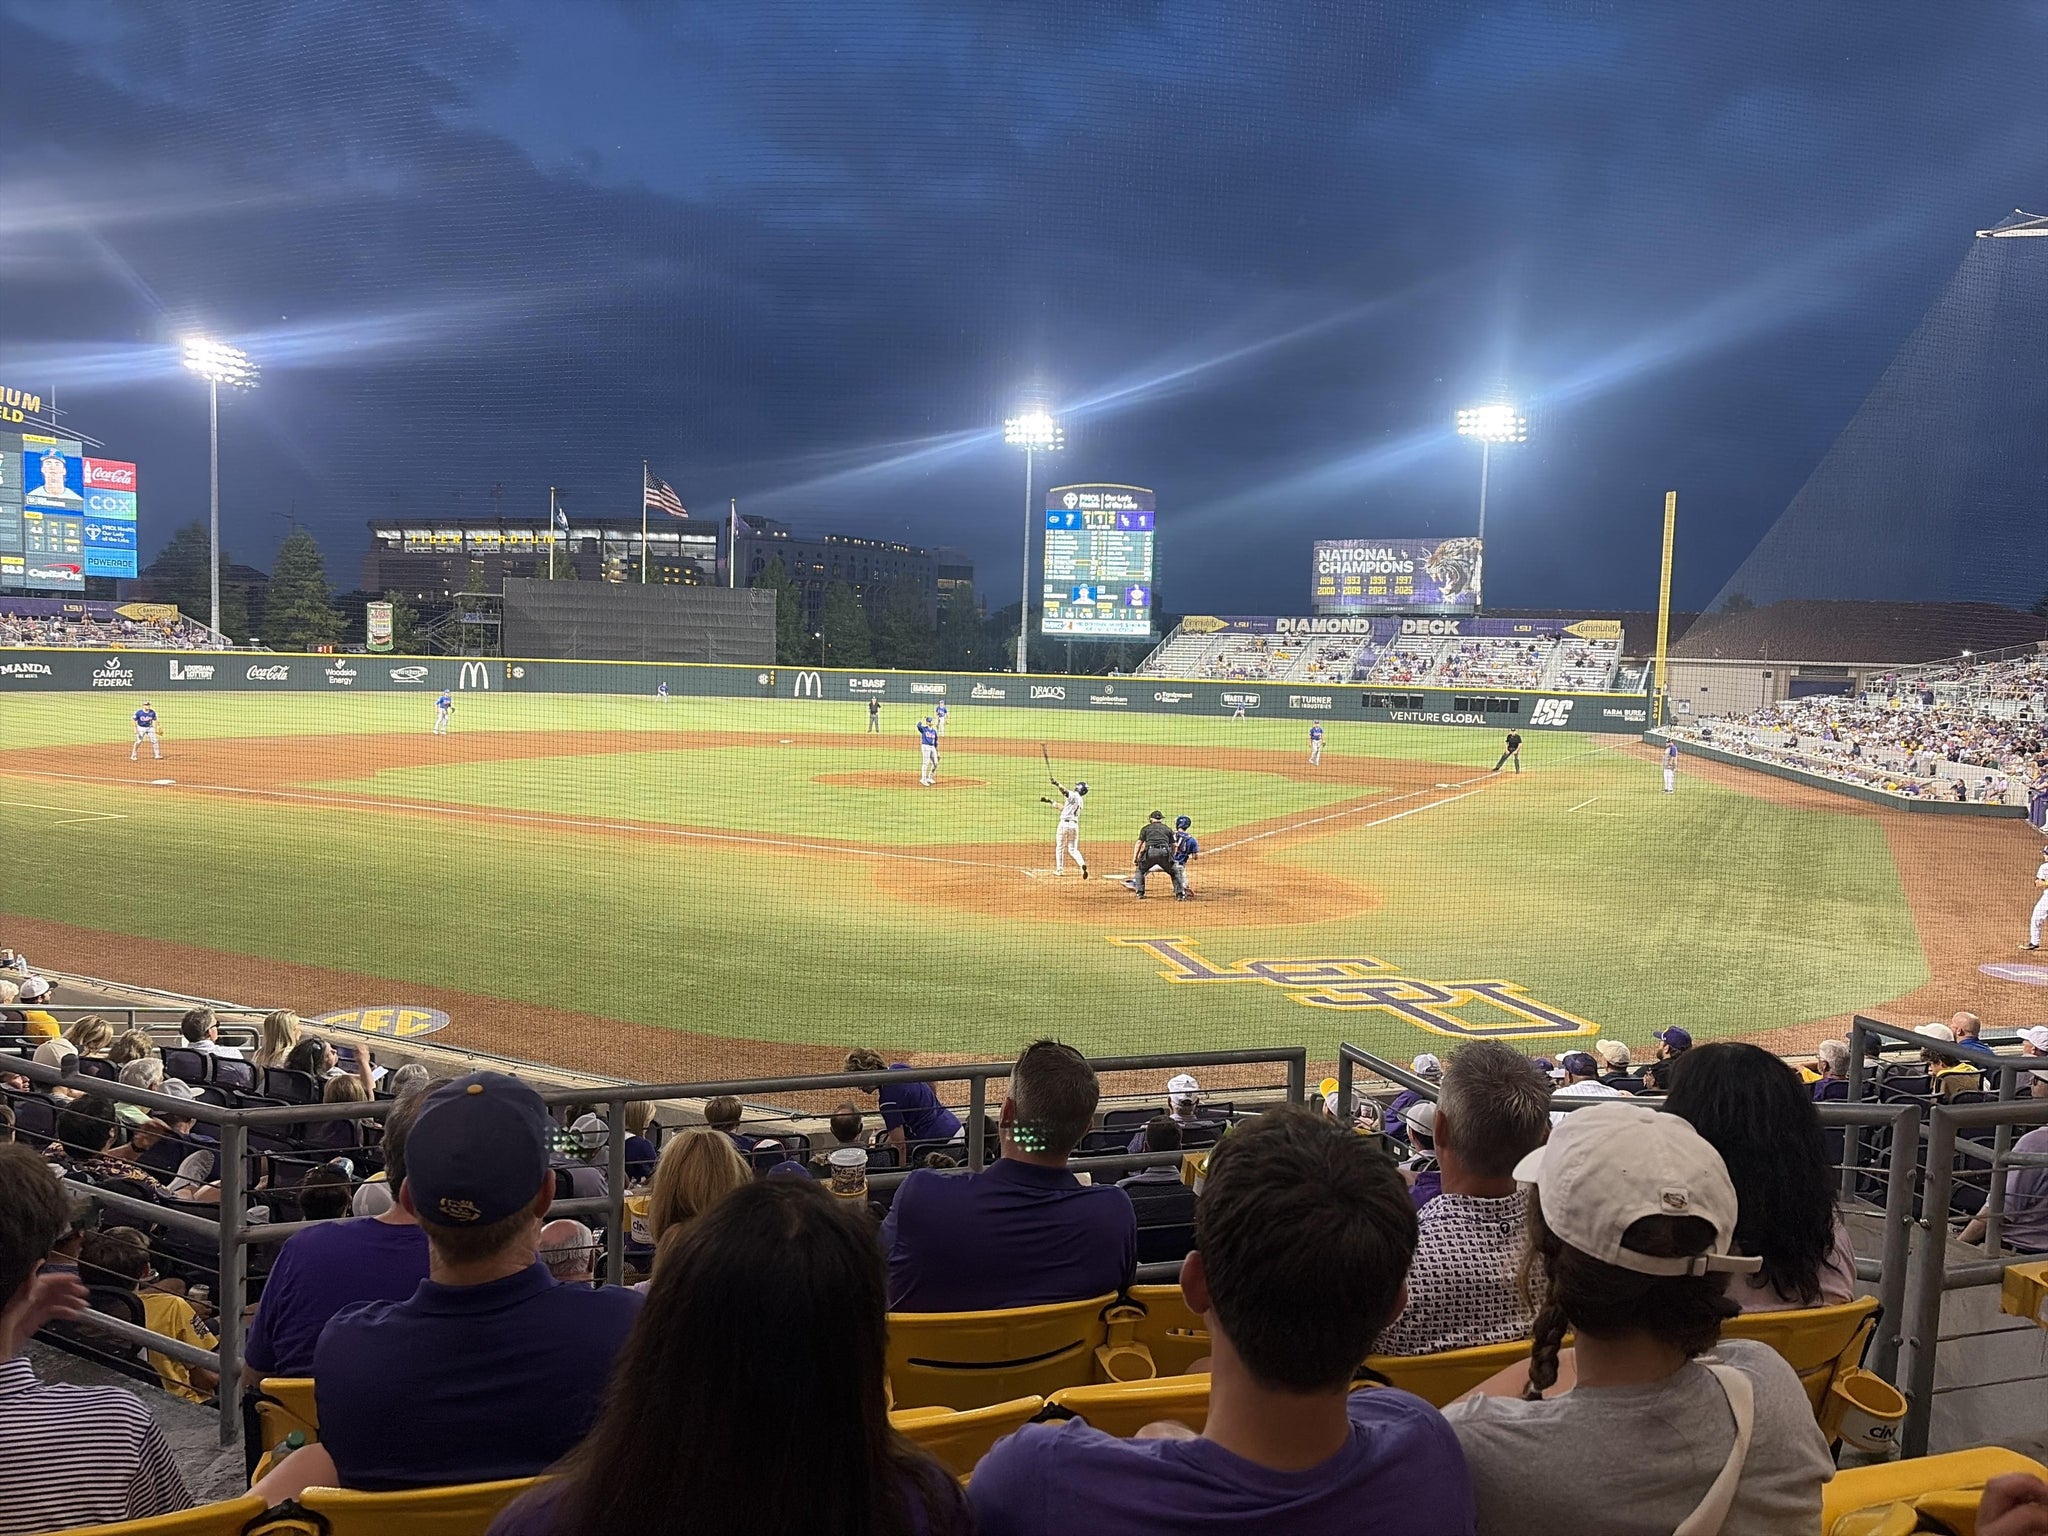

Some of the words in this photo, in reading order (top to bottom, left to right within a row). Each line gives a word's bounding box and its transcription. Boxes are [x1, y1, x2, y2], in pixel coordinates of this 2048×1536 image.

[92, 467, 132, 484] Coca-Cola
[90, 495, 130, 512] COX
[411, 535, 462, 544] TIGER
[475, 535, 556, 544] STADIUM
[1319, 548, 1396, 561] NATIONAL
[88, 558, 133, 568] POWERADE
[1319, 560, 1414, 574] CHAMPIONS
[1276, 618, 1370, 633] DIAMOND
[1402, 619, 1460, 635] DECK
[1578, 623, 1619, 634] Community
[0, 663, 52, 675] MANDA
[93, 669, 133, 678] CAMPUS
[246, 665, 290, 681] Coca-Cola
[325, 668, 357, 677] Woodside
[93, 679, 133, 687] FEDERAL
[329, 677, 353, 686] Energy
[862, 679, 886, 688] BASF
[912, 684, 945, 693] BADGER
[971, 687, 1005, 696] Acadian
[1223, 694, 1243, 703] WASTE
[1245, 694, 1257, 703] PRO
[1390, 711, 1440, 722] VENTURE
[1441, 713, 1486, 724] GLOBAL
[1530, 699, 1573, 726] ISC
[1104, 934, 1601, 1040] LSU
